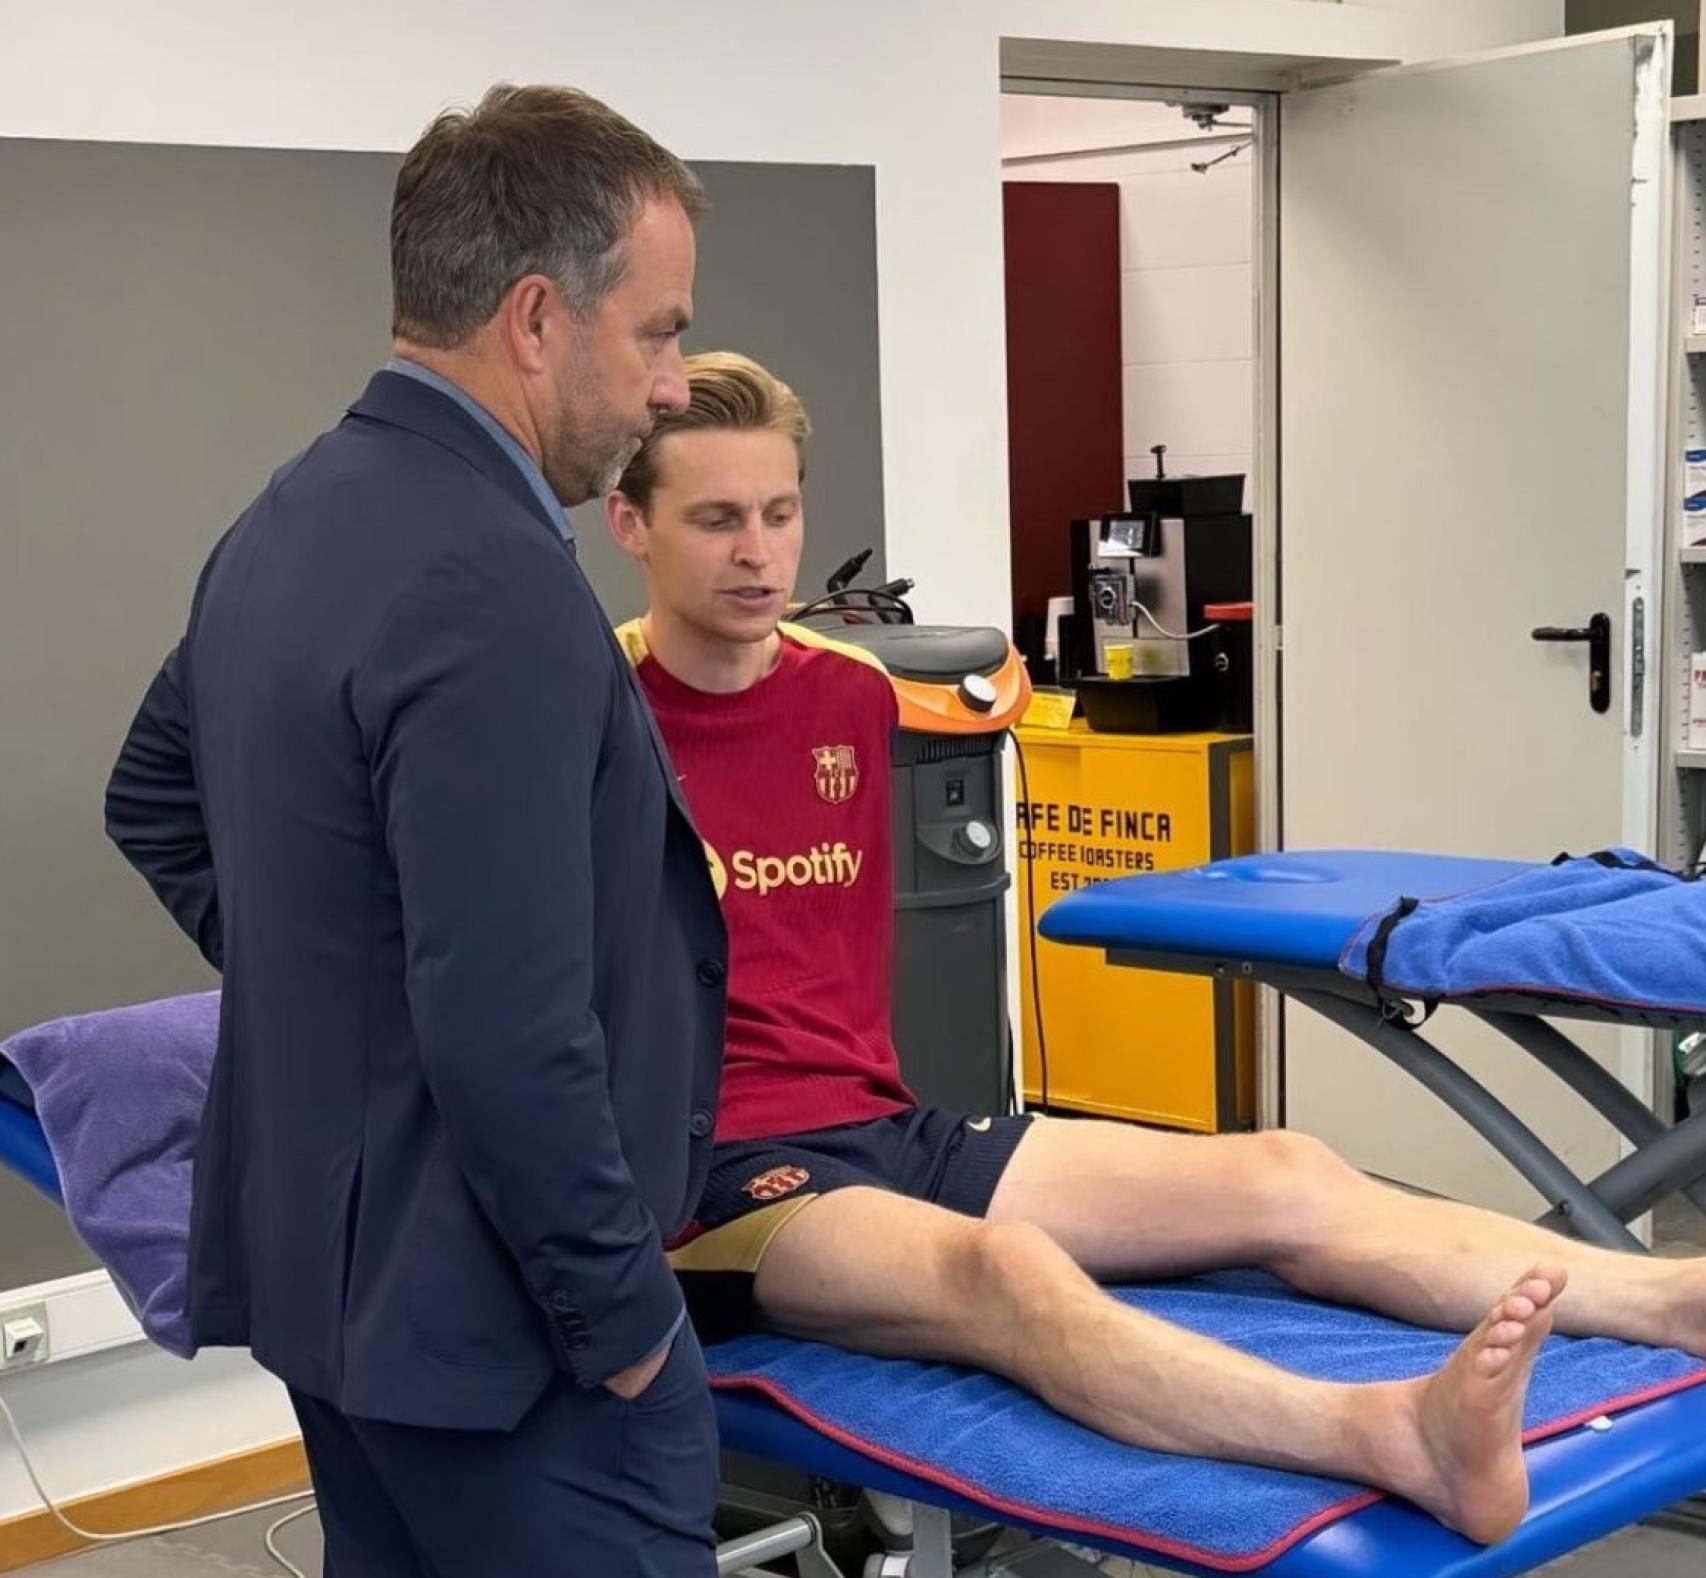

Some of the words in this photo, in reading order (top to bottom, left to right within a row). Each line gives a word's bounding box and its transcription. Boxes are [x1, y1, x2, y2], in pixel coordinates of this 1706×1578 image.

[1068, 804, 1092, 835] DE
[1101, 808, 1171, 842] FINCA
[1018, 840, 1076, 861] COFFEE
[732, 842, 863, 896] Spotify
[1050, 871, 1079, 890] EST
